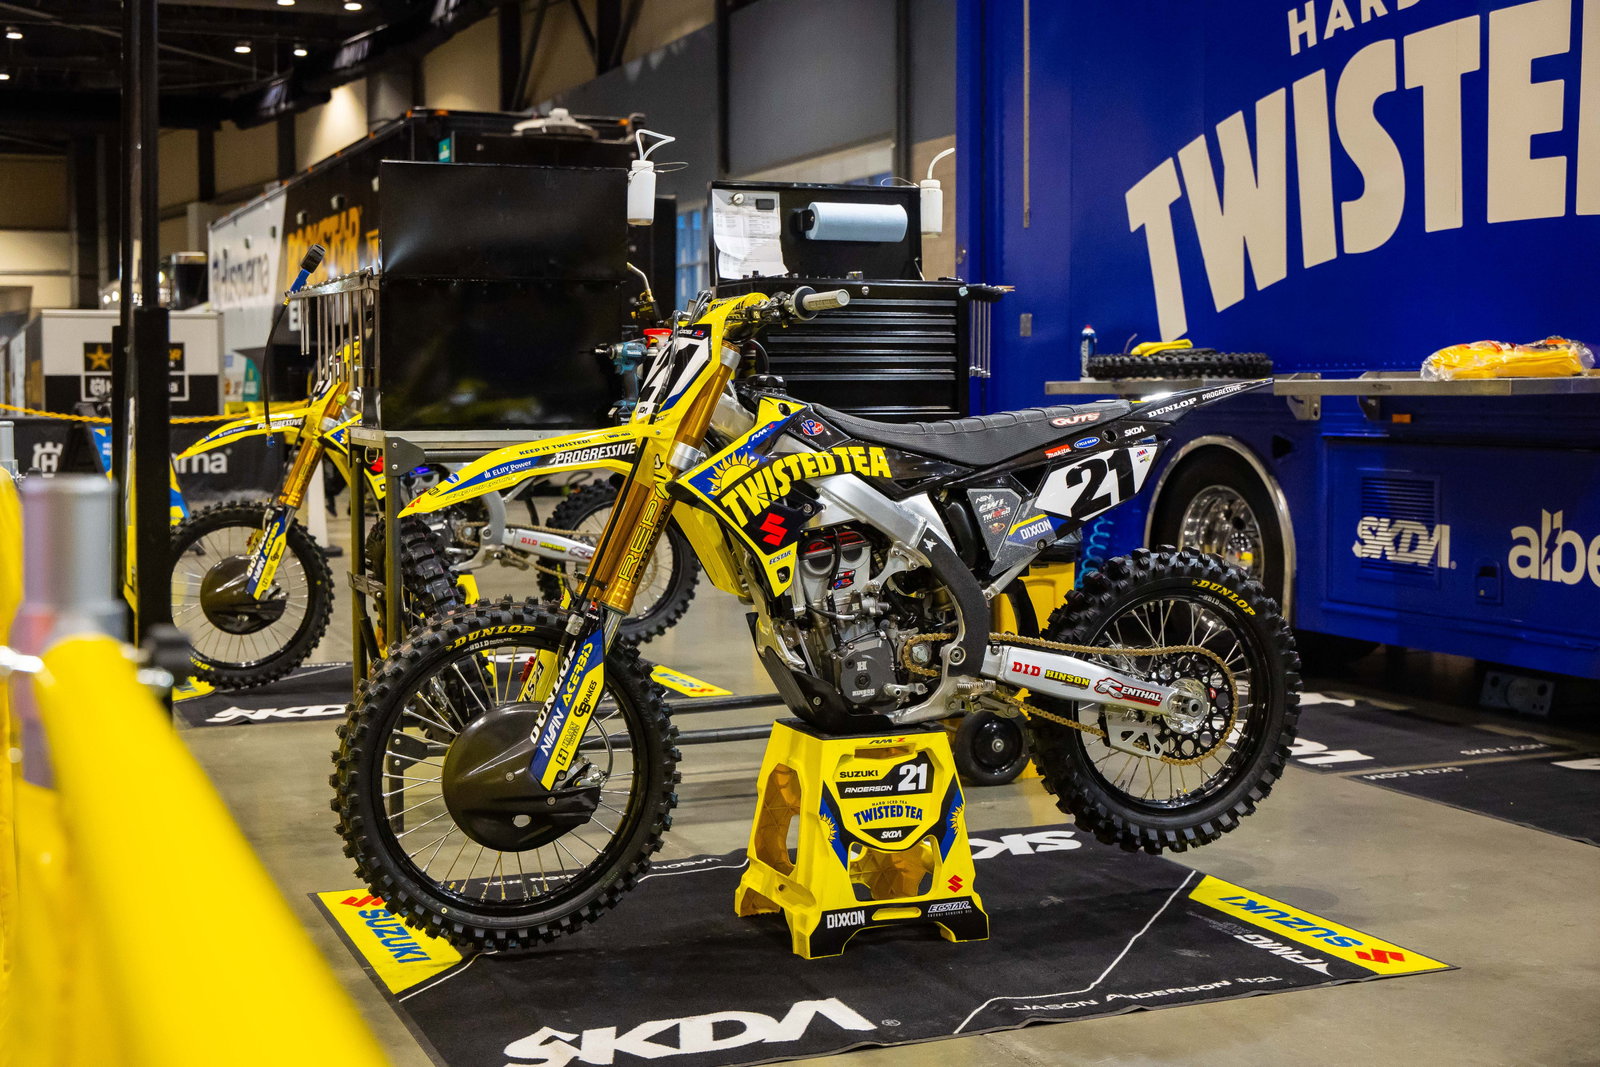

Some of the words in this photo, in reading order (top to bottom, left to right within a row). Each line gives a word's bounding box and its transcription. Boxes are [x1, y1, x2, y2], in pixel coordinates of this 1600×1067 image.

[1147, 397, 1197, 418] DUNLOP
[1202, 385, 1241, 401] PROGRESSIVE
[1052, 412, 1101, 426] GUTS
[1124, 425, 1147, 438] SKDA
[519, 446, 540, 456] KEEP
[551, 438, 592, 450] TWISTED!
[555, 442, 636, 465] PROGRESSIVE
[510, 460, 532, 475] Power
[720, 450, 837, 528] TWISTED
[836, 446, 893, 479] TEA
[1065, 448, 1135, 521] 21
[1020, 519, 1052, 540] DIXXON
[1352, 515, 1450, 569] SKDA
[1197, 579, 1256, 616] DUNLOP
[454, 624, 536, 648] DUNLOP
[562, 642, 594, 707] ACERBIS
[1045, 669, 1091, 687] HINSON
[205, 704, 347, 722] SKD
[840, 770, 878, 778] SUZUKI
[898, 763, 928, 791] 21
[844, 785, 893, 793] ANDERSON
[854, 804, 903, 826] TWISTED
[904, 805, 923, 821] TEA
[881, 830, 902, 839] SKDA
[967, 830, 1082, 860] SK
[927, 900, 972, 914] ECSTAR
[826, 910, 865, 929] DIXXON
[1217, 895, 1364, 948] SUZUKI
[358, 909, 432, 963] SUZUKI
[1233, 933, 1324, 964] PMG
[1013, 999, 1099, 1011] JASON
[503, 997, 877, 1067] SKDA
